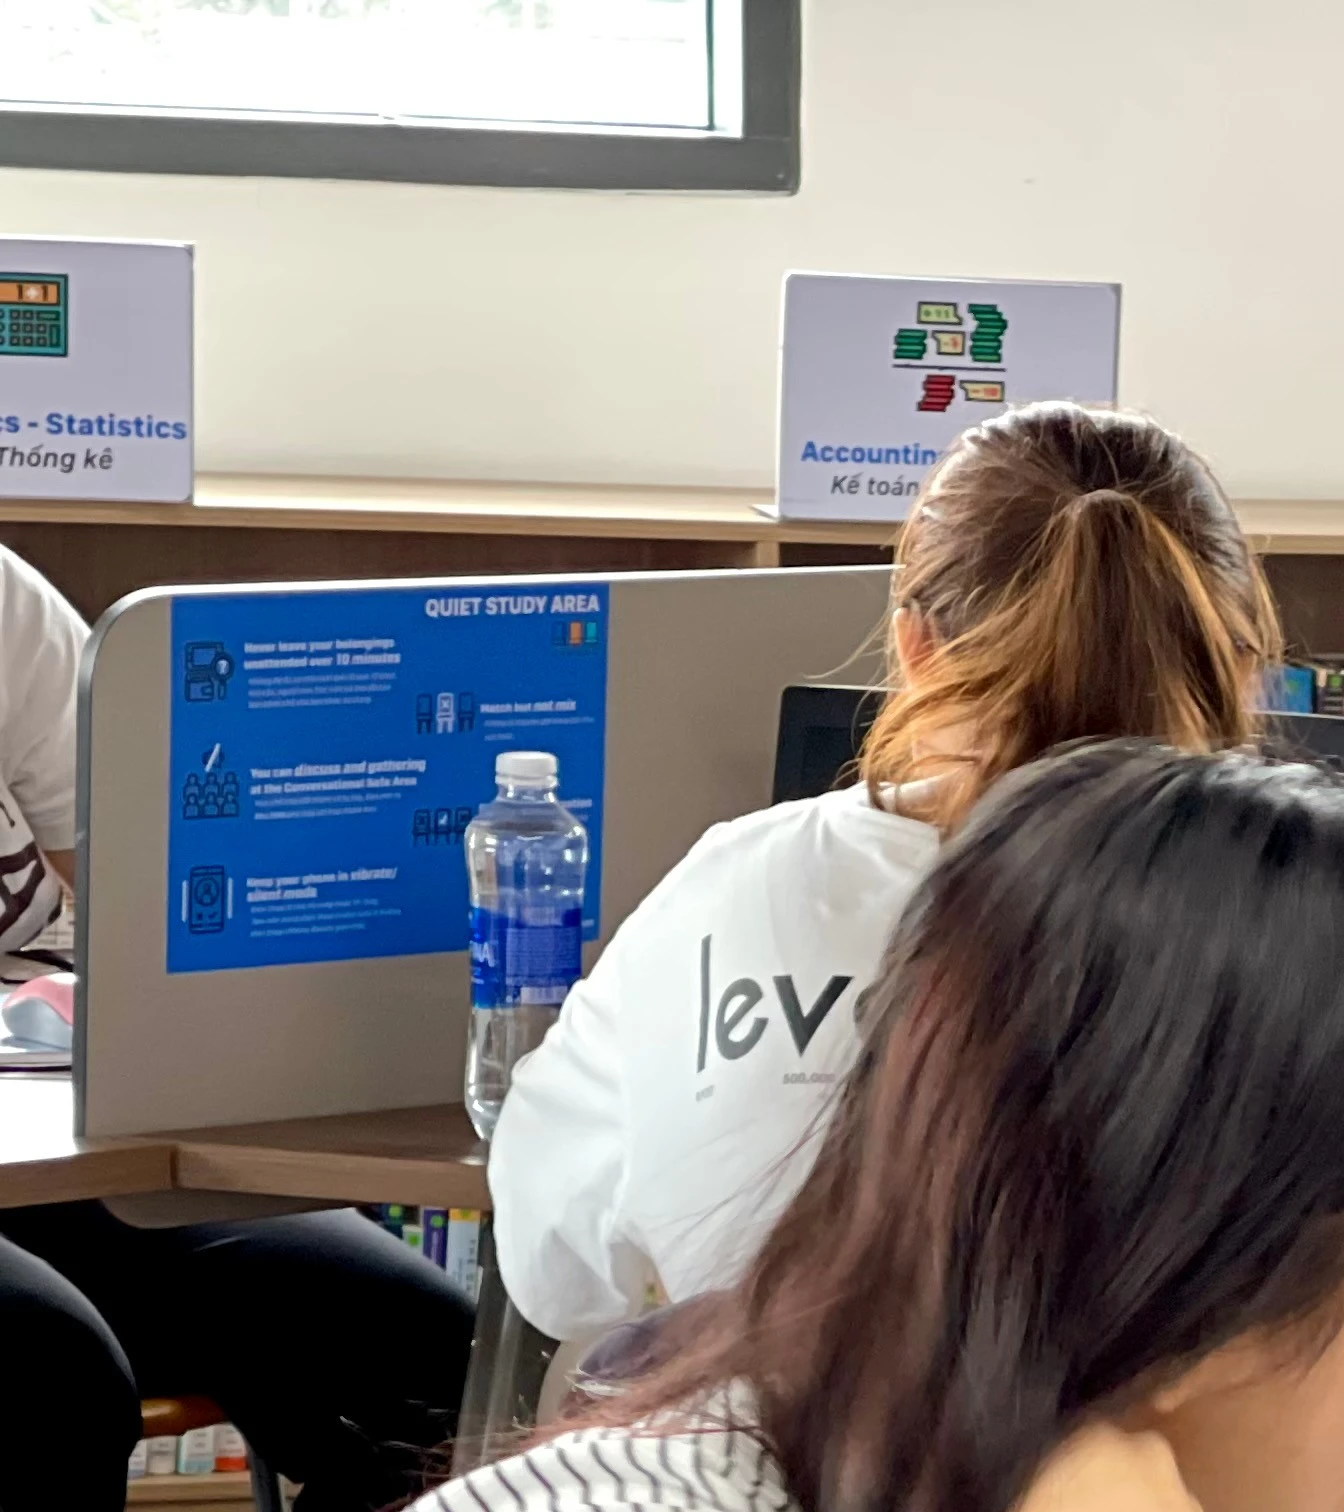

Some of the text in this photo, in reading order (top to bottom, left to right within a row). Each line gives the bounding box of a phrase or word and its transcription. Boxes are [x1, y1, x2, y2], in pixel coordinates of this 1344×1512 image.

[46, 412, 187, 440] Statistics
[0, 444, 113, 474] Thống kê
[801, 441, 937, 465] Accountin
[830, 472, 920, 496] Kế toán
[425, 594, 600, 618] QUIET STUDY AREA
[697, 934, 870, 1074] lev
